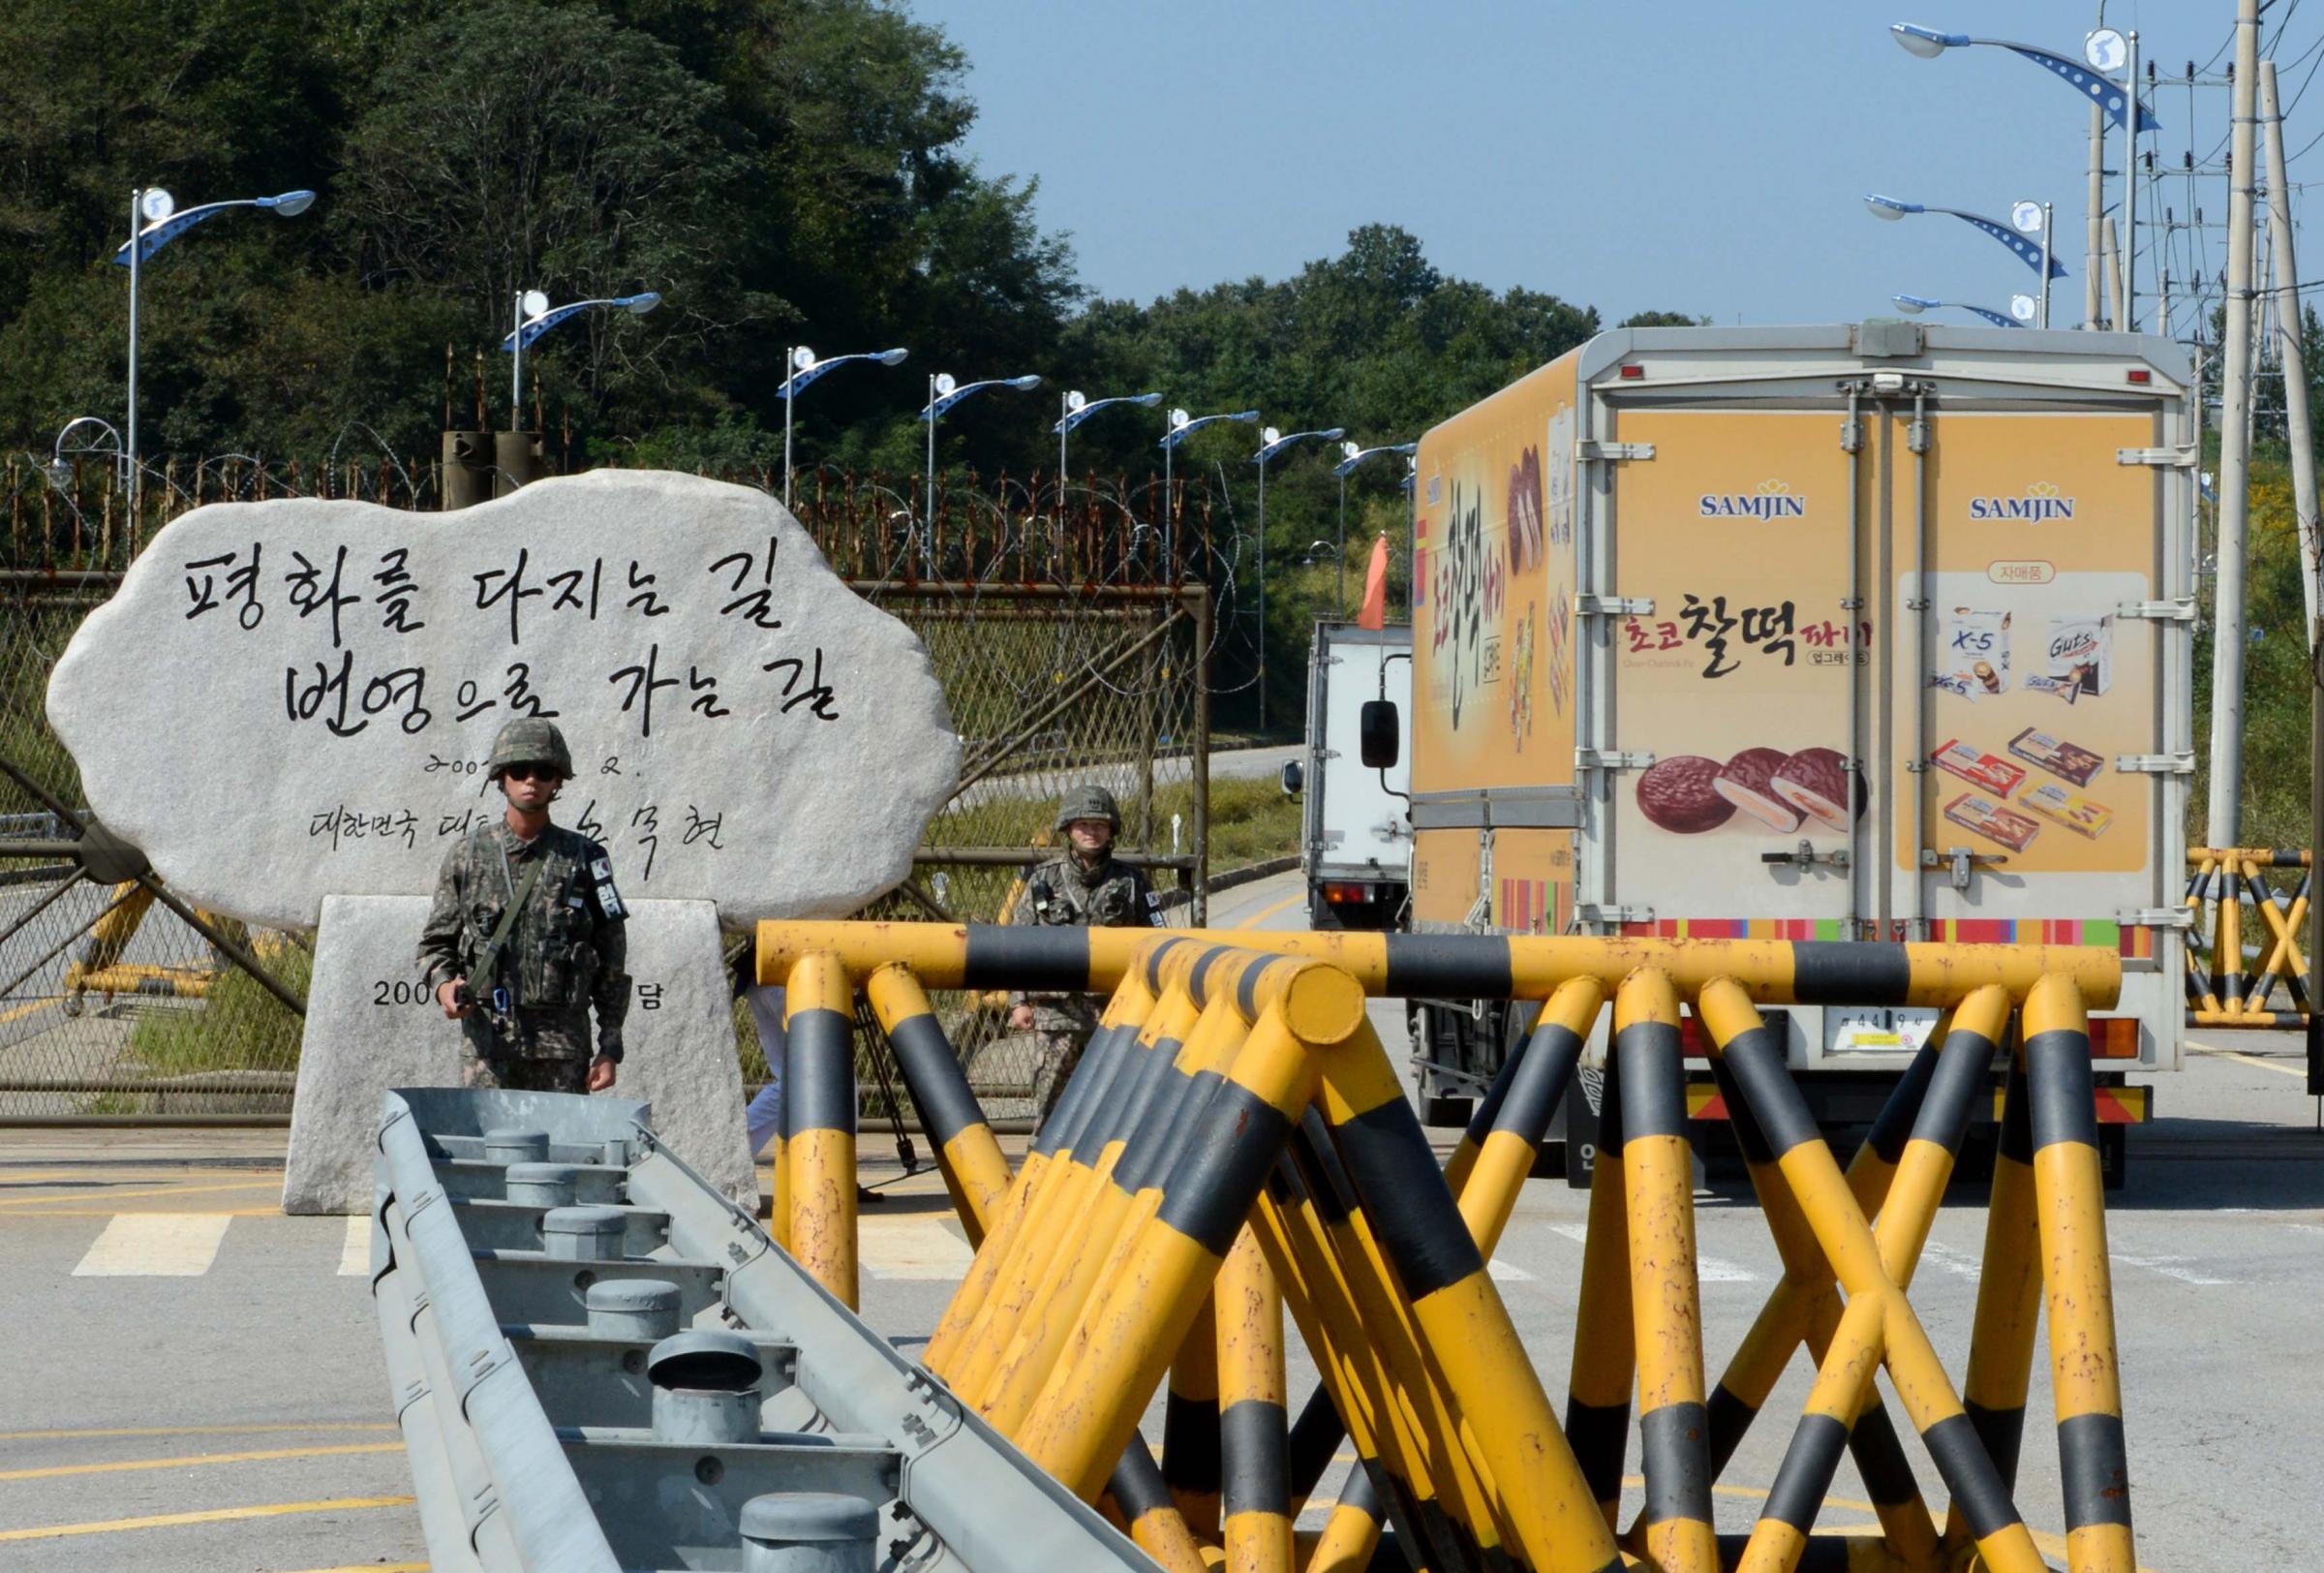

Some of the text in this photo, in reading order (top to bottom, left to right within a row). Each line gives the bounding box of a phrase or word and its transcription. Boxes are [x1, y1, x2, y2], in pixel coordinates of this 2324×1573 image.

[1700, 495, 1804, 520] SAMJIN
[1971, 498, 2073, 523] SAMJIN
[1999, 565, 2041, 580] 자매품
[185, 537, 781, 647] 평화를 다지는 길
[1952, 630, 1994, 650] X-5
[2050, 632, 2091, 658] Guts
[287, 643, 839, 737] 번영으로 가는 길
[309, 804, 419, 851] 대한민국
